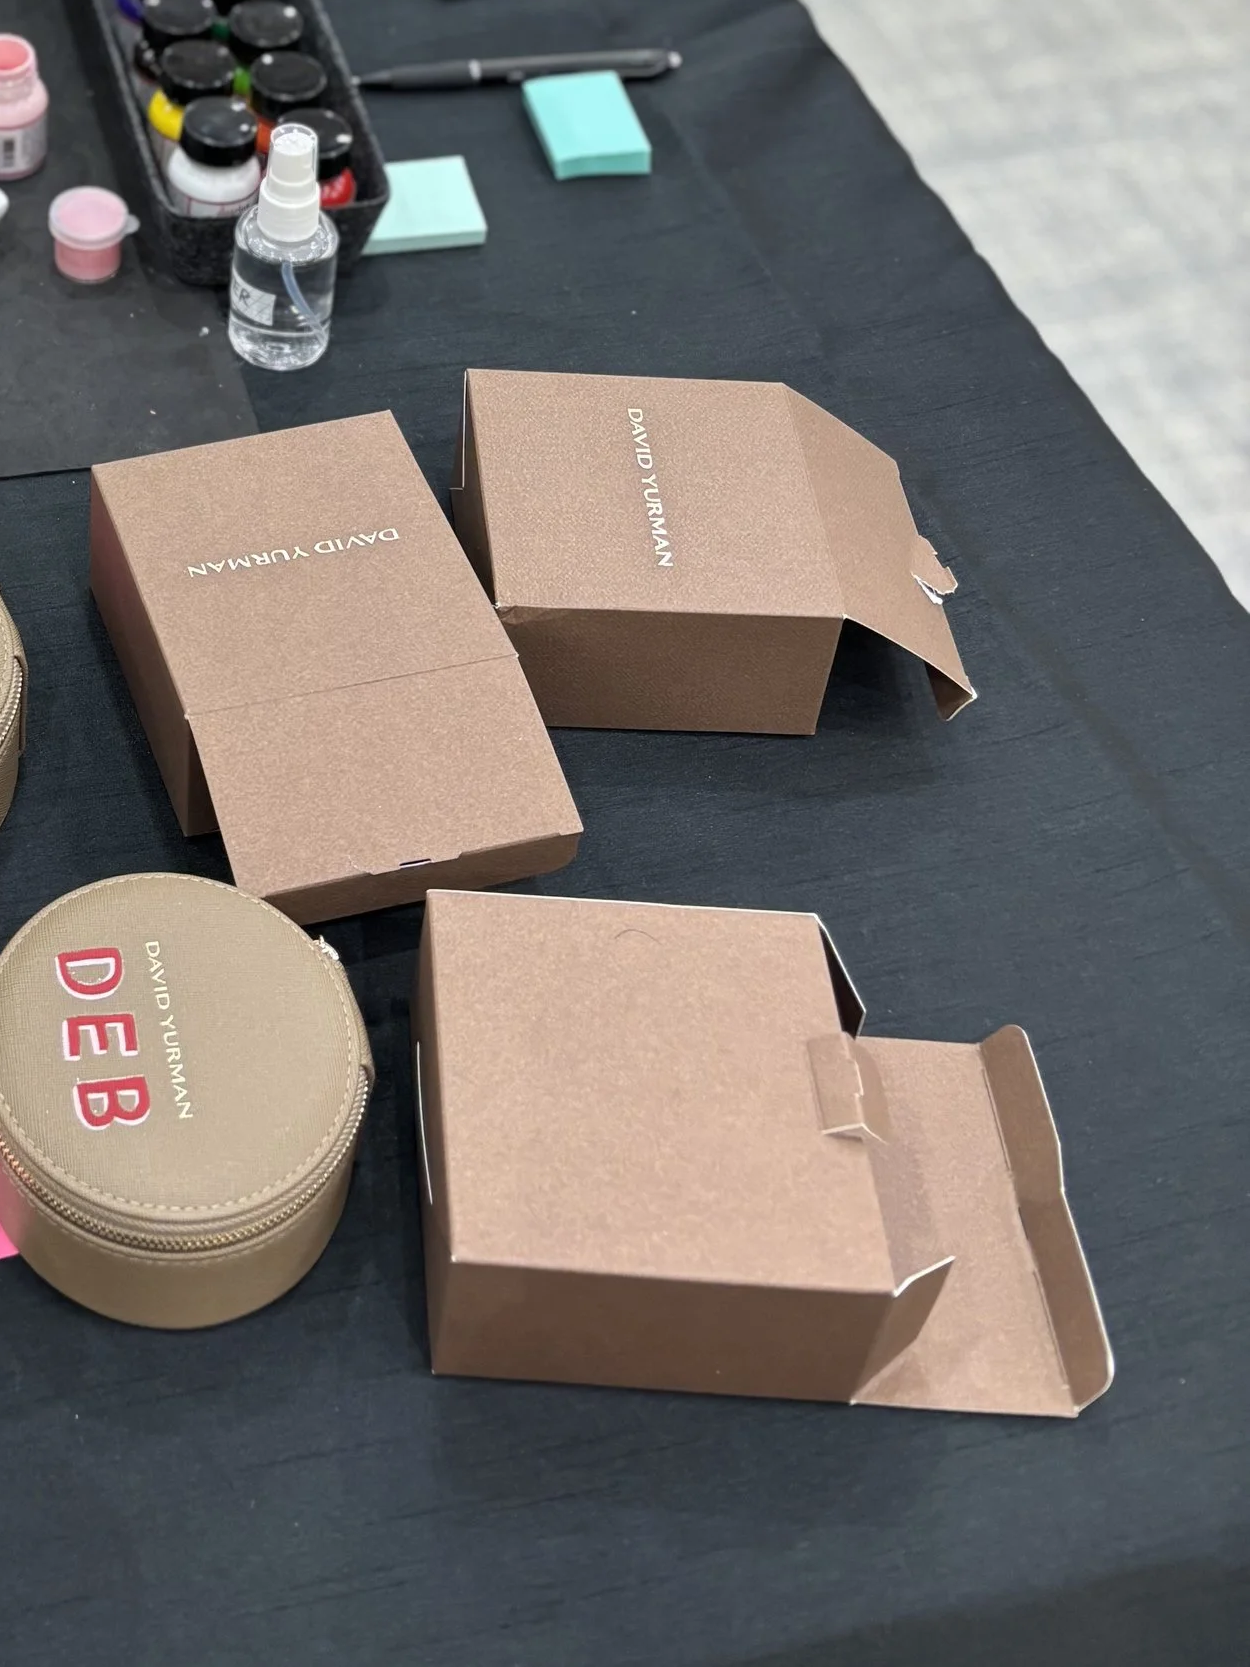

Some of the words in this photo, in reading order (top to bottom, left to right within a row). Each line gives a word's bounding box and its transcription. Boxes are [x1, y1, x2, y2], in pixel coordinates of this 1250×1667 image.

[187, 546, 310, 578] YURMAN
[313, 527, 400, 554] DAVID
[627, 408, 653, 470] DAVID
[641, 474, 674, 567] YURMAN
[55, 946, 151, 1131] DEB
[145, 940, 171, 1011] DAVID
[159, 1014, 194, 1120] YURMAN
